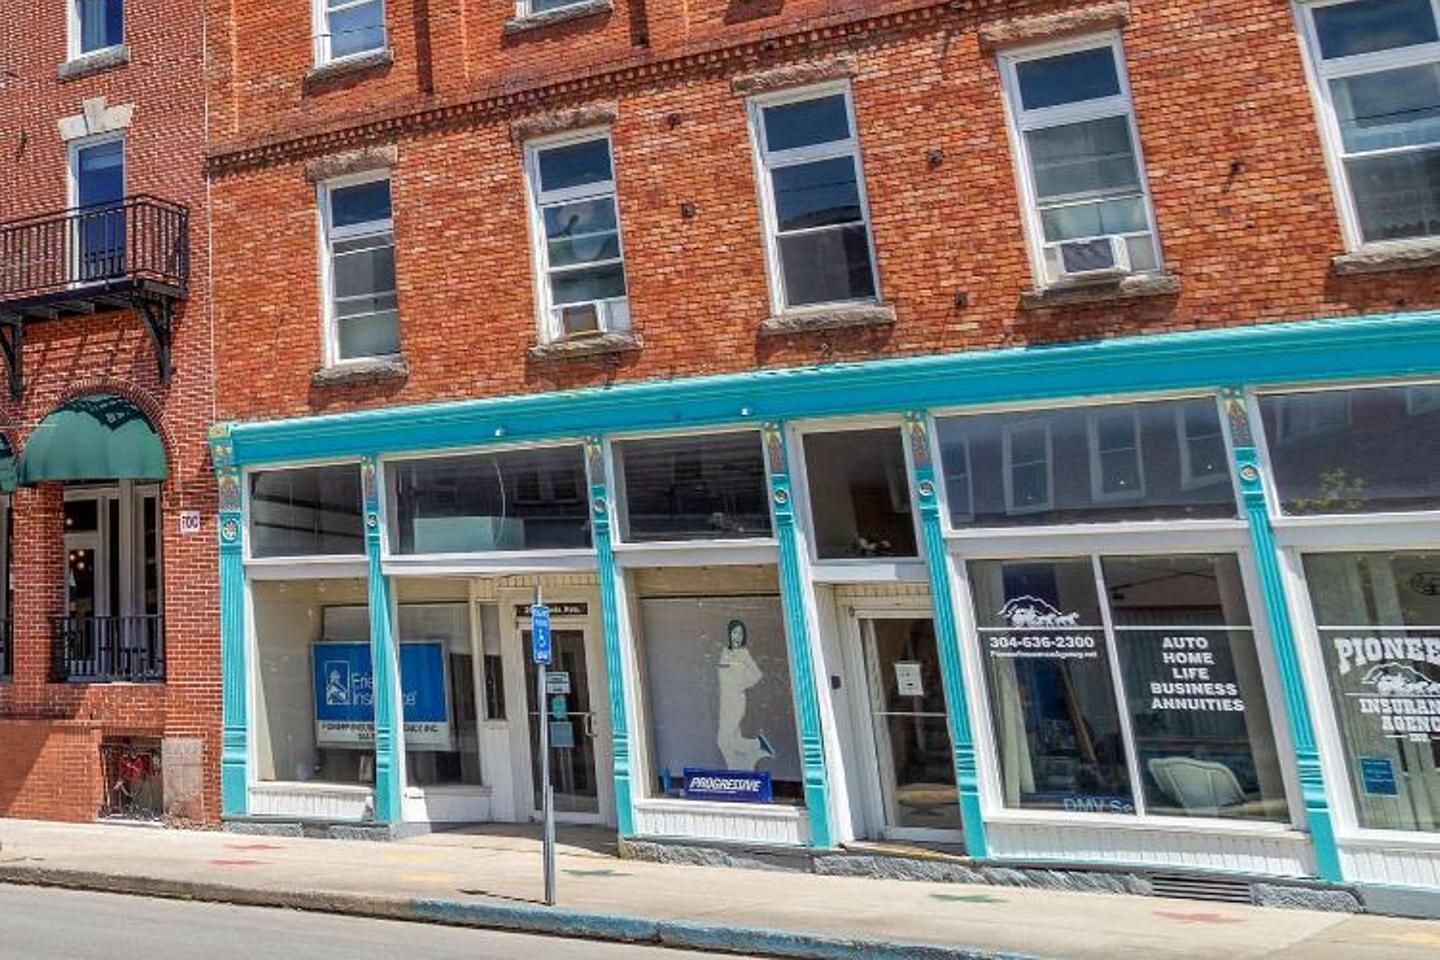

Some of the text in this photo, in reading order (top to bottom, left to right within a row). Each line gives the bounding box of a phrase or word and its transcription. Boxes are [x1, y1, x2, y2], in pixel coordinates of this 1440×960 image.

[990, 637, 1095, 648] 304-636-2300
[1162, 637, 1209, 649] AUTO
[1162, 652, 1215, 665] HOME
[1172, 668, 1210, 680] LIFE
[1150, 683, 1238, 696] BUSINESS
[1151, 698, 1245, 711] ANNUITIES
[689, 777, 762, 792] PROGRESSIVE
